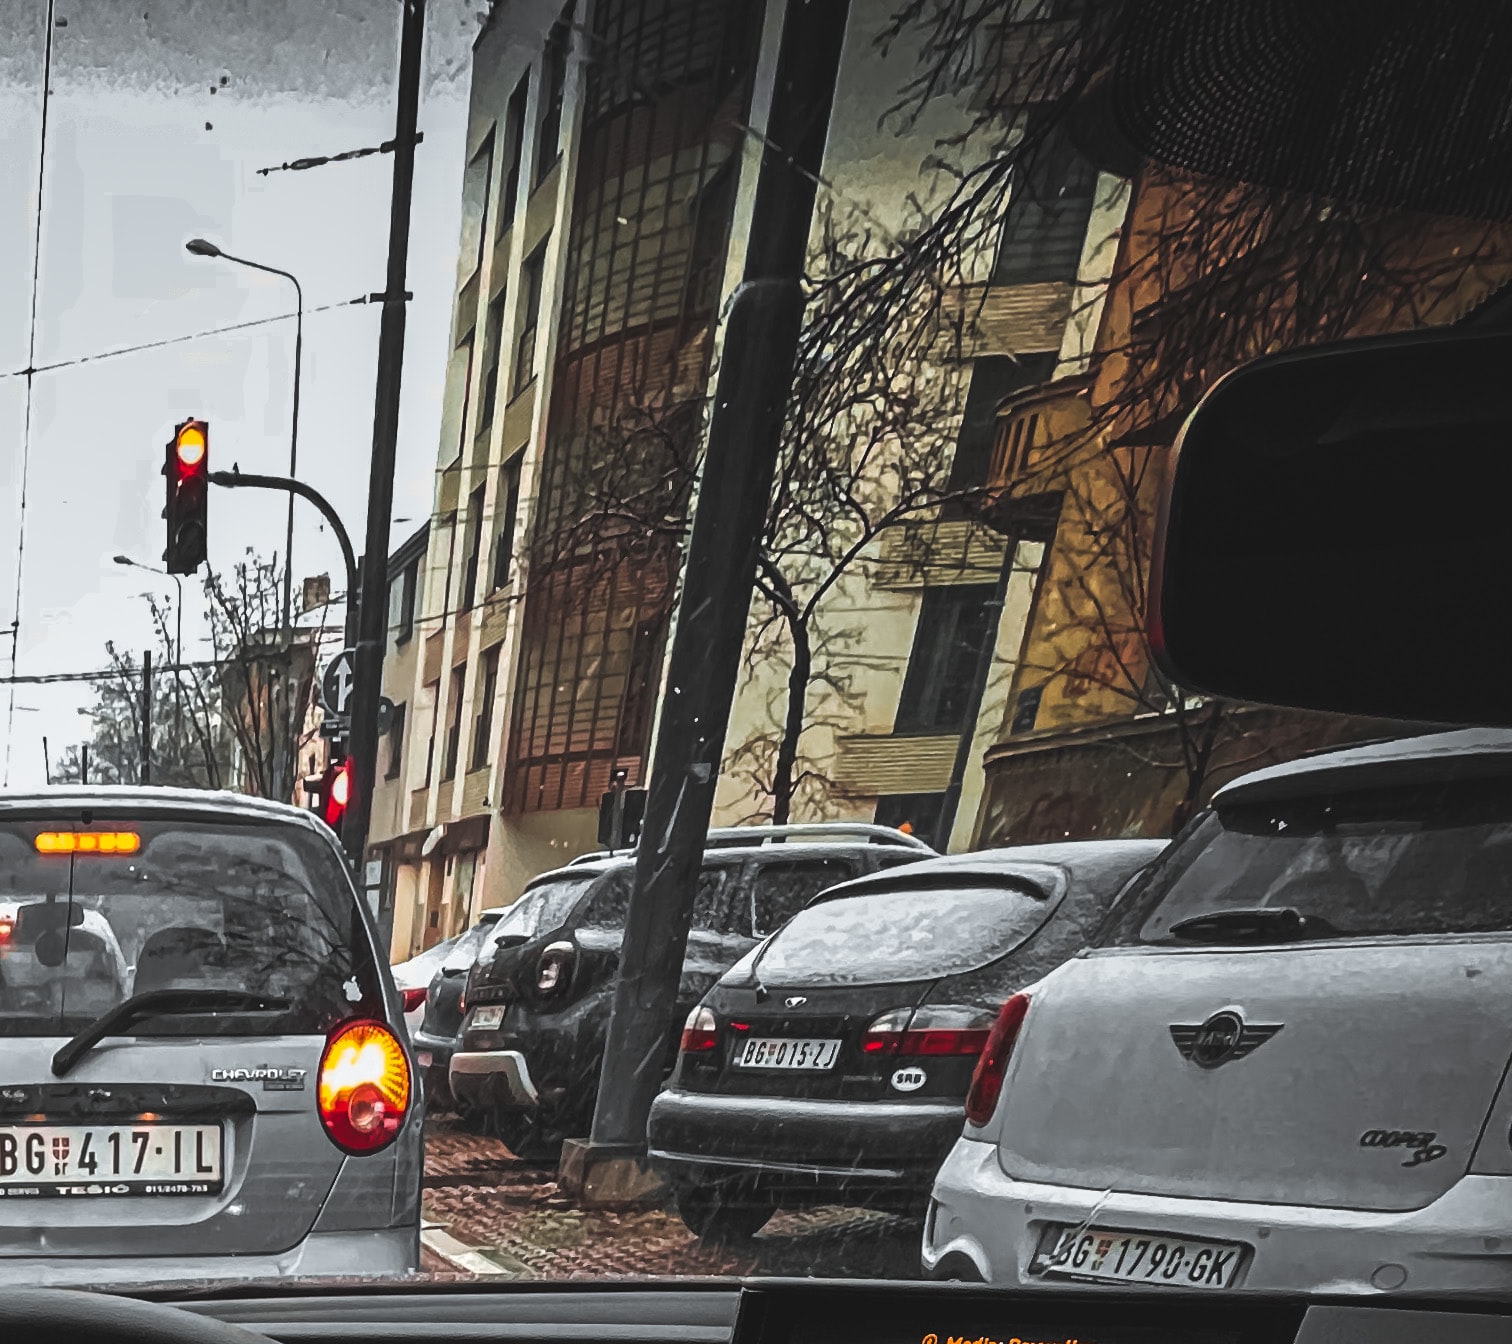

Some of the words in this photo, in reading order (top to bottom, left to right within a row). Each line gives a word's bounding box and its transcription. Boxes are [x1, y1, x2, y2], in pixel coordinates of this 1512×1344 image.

[743, 1041, 768, 1065] BG
[212, 1068, 307, 1082] CHEVROLET
[1359, 1129, 1437, 1148] COOPER
